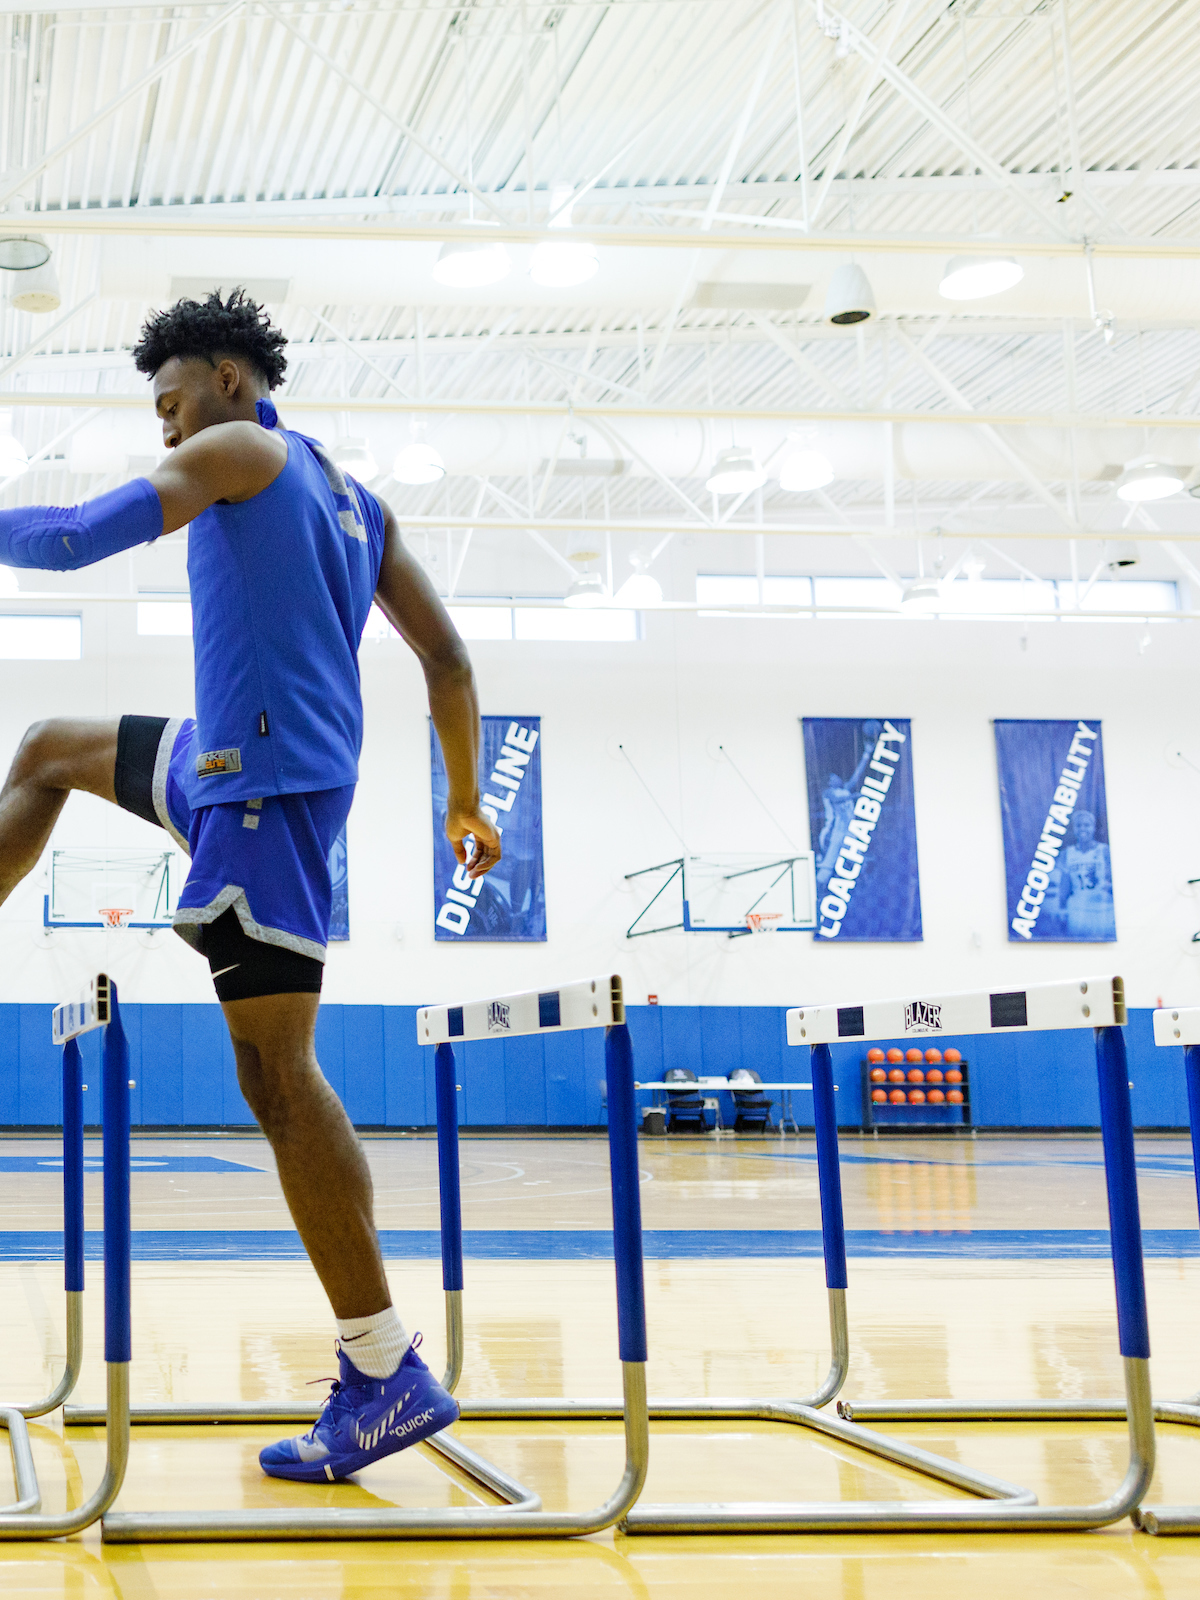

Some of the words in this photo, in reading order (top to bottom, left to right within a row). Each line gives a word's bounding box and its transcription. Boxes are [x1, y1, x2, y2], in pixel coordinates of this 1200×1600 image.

[436, 721, 539, 935] DISPLINE
[818, 720, 907, 938] COACHABILITY
[1011, 720, 1098, 939] ACCOUNTABILITY
[904, 1001, 943, 1031] BLAZER
[389, 1407, 436, 1439] "QUICK"
